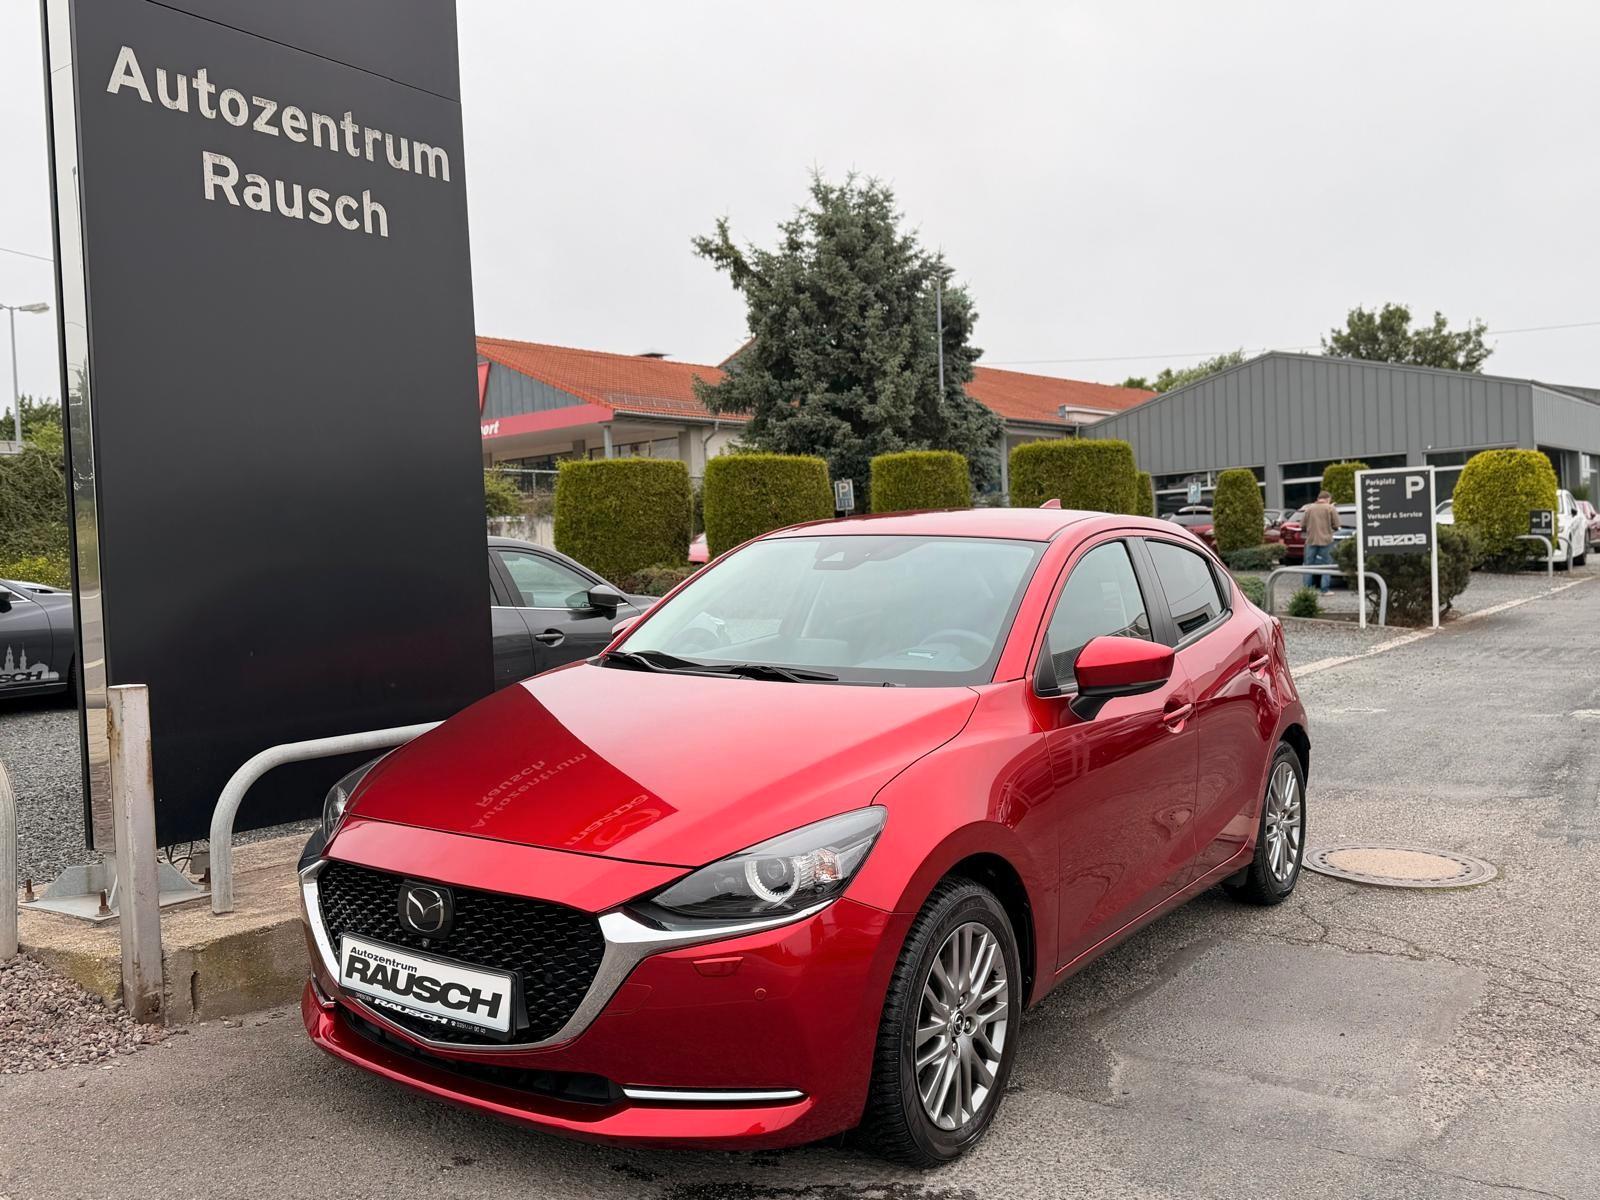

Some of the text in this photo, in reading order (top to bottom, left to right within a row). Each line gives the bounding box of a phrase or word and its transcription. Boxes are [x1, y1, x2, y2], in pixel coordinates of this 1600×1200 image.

[106, 45, 451, 182] Autozentrum
[202, 150, 389, 238] Rausch
[839, 483, 849, 498] P
[1365, 478, 1396, 486] Parkplatz
[1405, 475, 1425, 499] P
[1367, 511, 1423, 520] Verkauf & Service
[1541, 511, 1551, 528] P
[1367, 533, 1427, 547] mazda
[350, 946, 418, 973] Autozentrum
[345, 955, 503, 1019] RAUSCH
[374, 998, 448, 1025] RAUSCH
